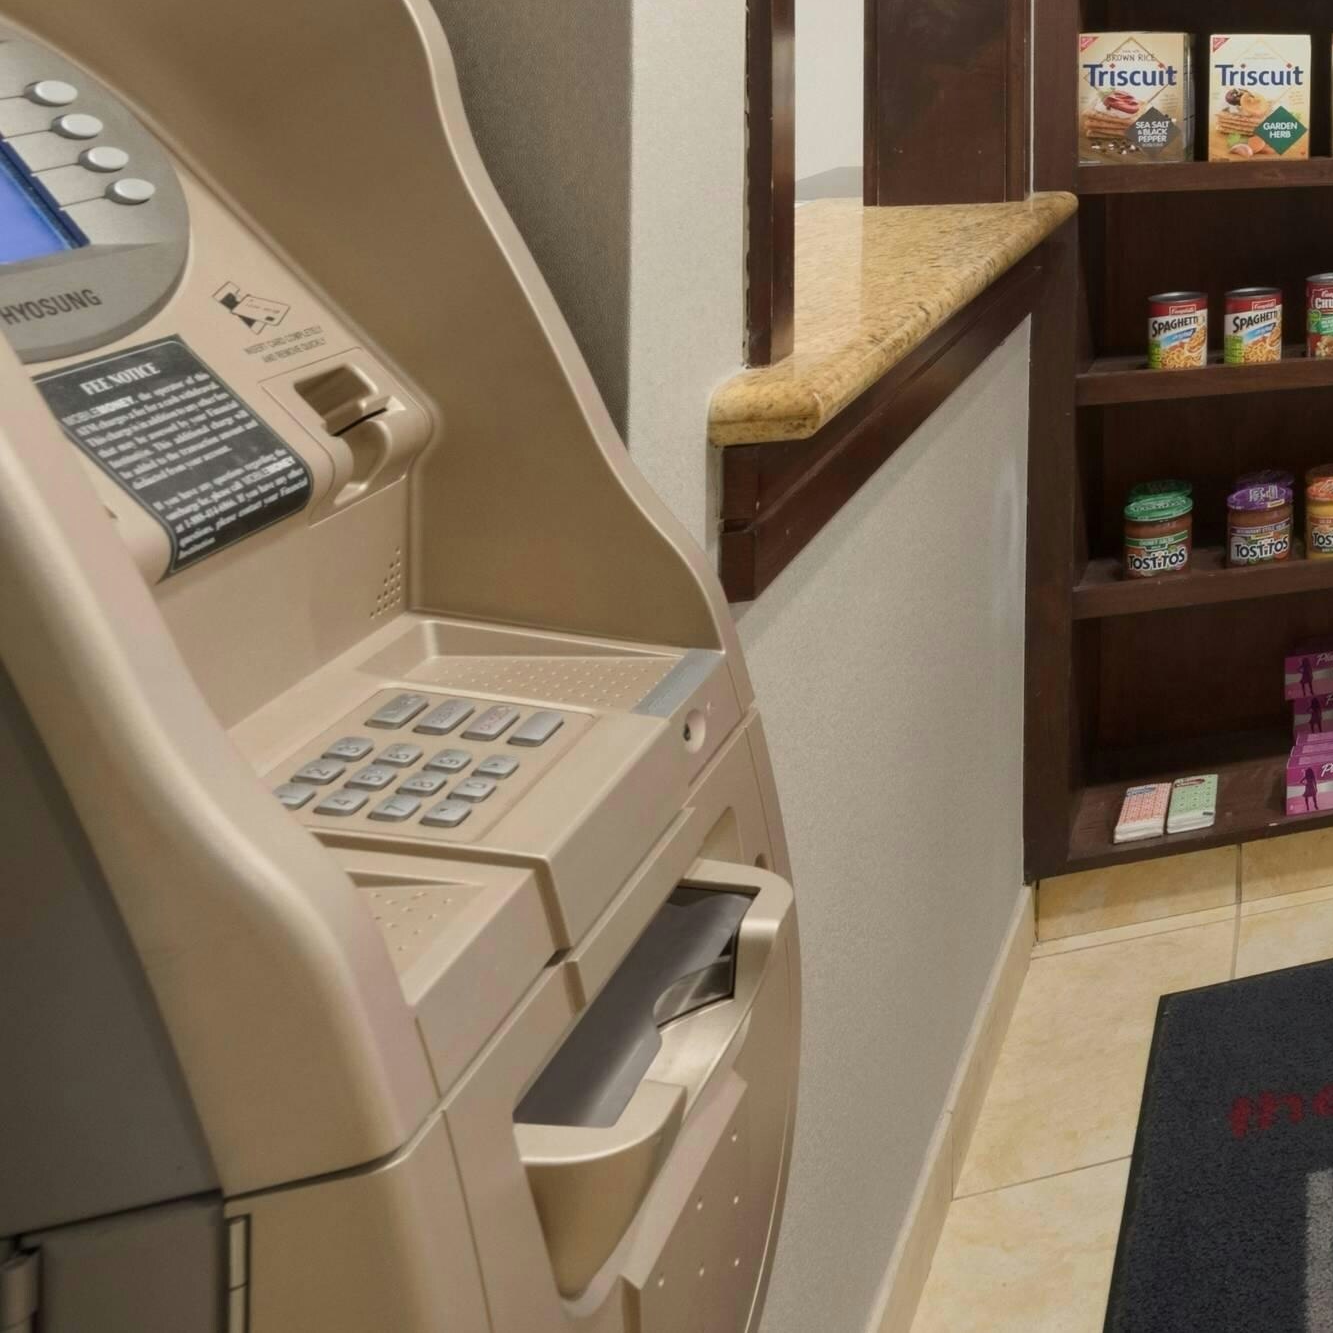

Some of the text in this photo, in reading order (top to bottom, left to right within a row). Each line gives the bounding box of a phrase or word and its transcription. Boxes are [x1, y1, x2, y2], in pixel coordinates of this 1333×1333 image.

[1083, 63, 1178, 86] Triscuit
[1215, 63, 1304, 86] Triscuit
[1263, 121, 1298, 131] GARDEN
[1, 288, 103, 326] HYOSUNG
[80, 362, 161, 396] FEE NOTICE
[1128, 548, 1186, 572] TOSTITOS
[1235, 538, 1288, 559] TOSTITOS
